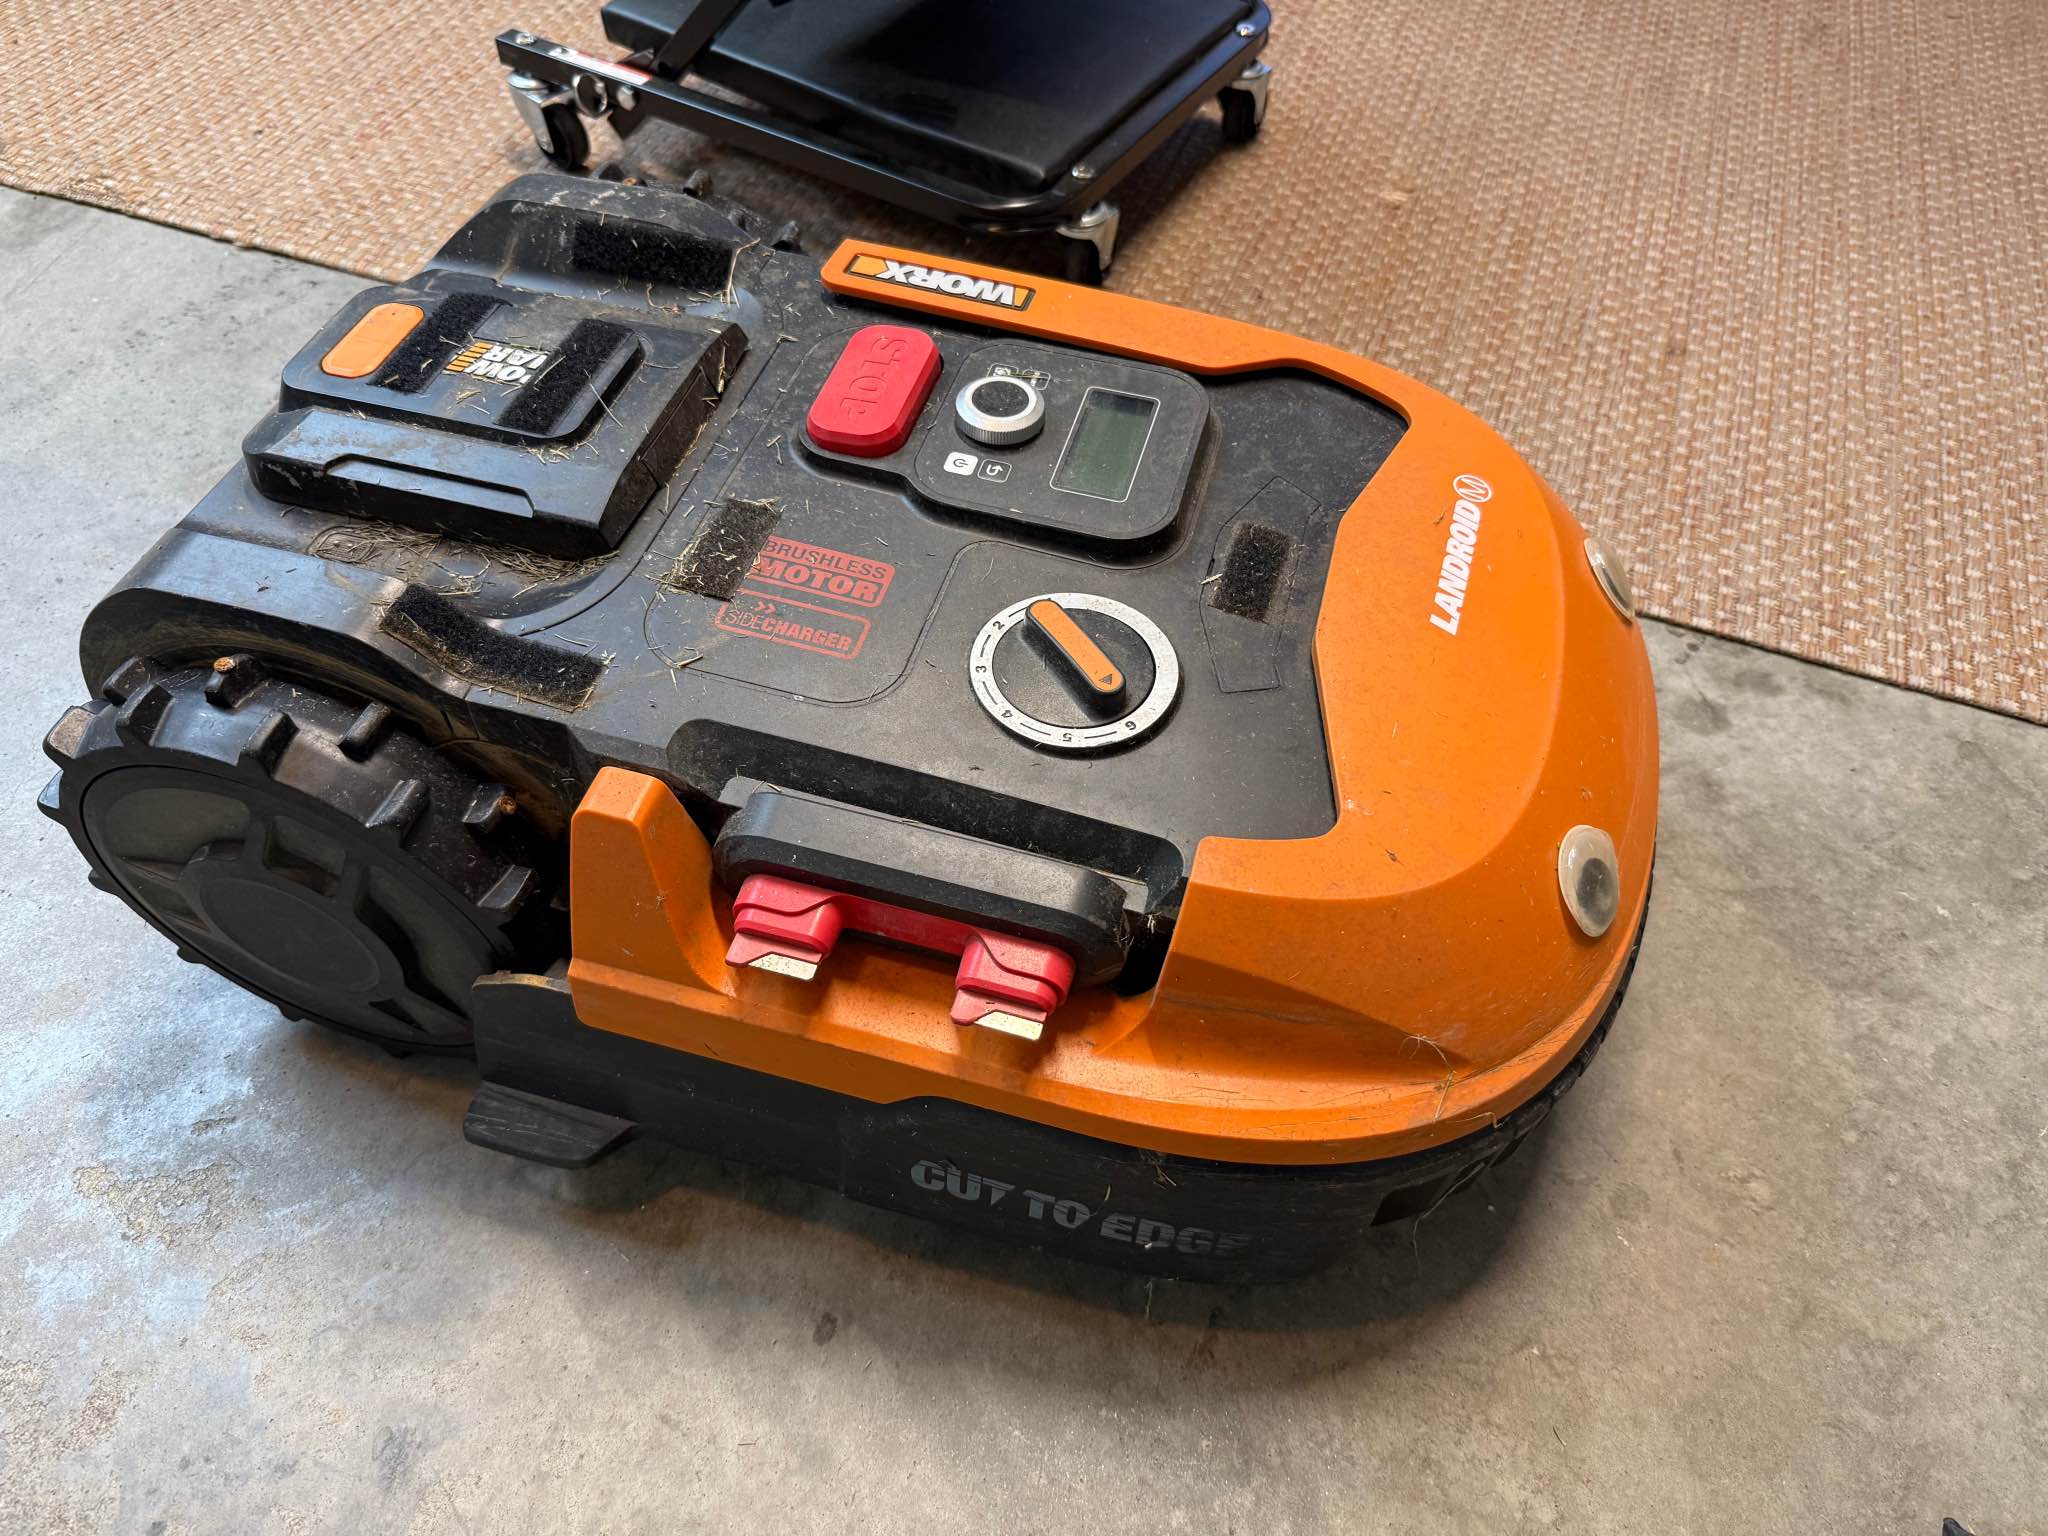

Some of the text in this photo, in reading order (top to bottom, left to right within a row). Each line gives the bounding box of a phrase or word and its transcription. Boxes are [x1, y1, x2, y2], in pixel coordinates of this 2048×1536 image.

[875, 260, 1015, 306] WORX
[840, 336, 909, 421] STOP
[757, 557, 880, 602] MOTOR
[764, 540, 887, 580] BRUSHLESS
[1429, 498, 1481, 635] LANDROID
[725, 609, 853, 650] SIDECHARGER
[992, 620, 1005, 631] 2
[975, 665, 987, 674] 3
[1000, 709, 1013, 719] 4
[1124, 720, 1137, 731] 6
[1062, 732, 1073, 743] 5
[910, 1159, 1016, 1206] CUT
[1022, 1189, 1092, 1230] TO
